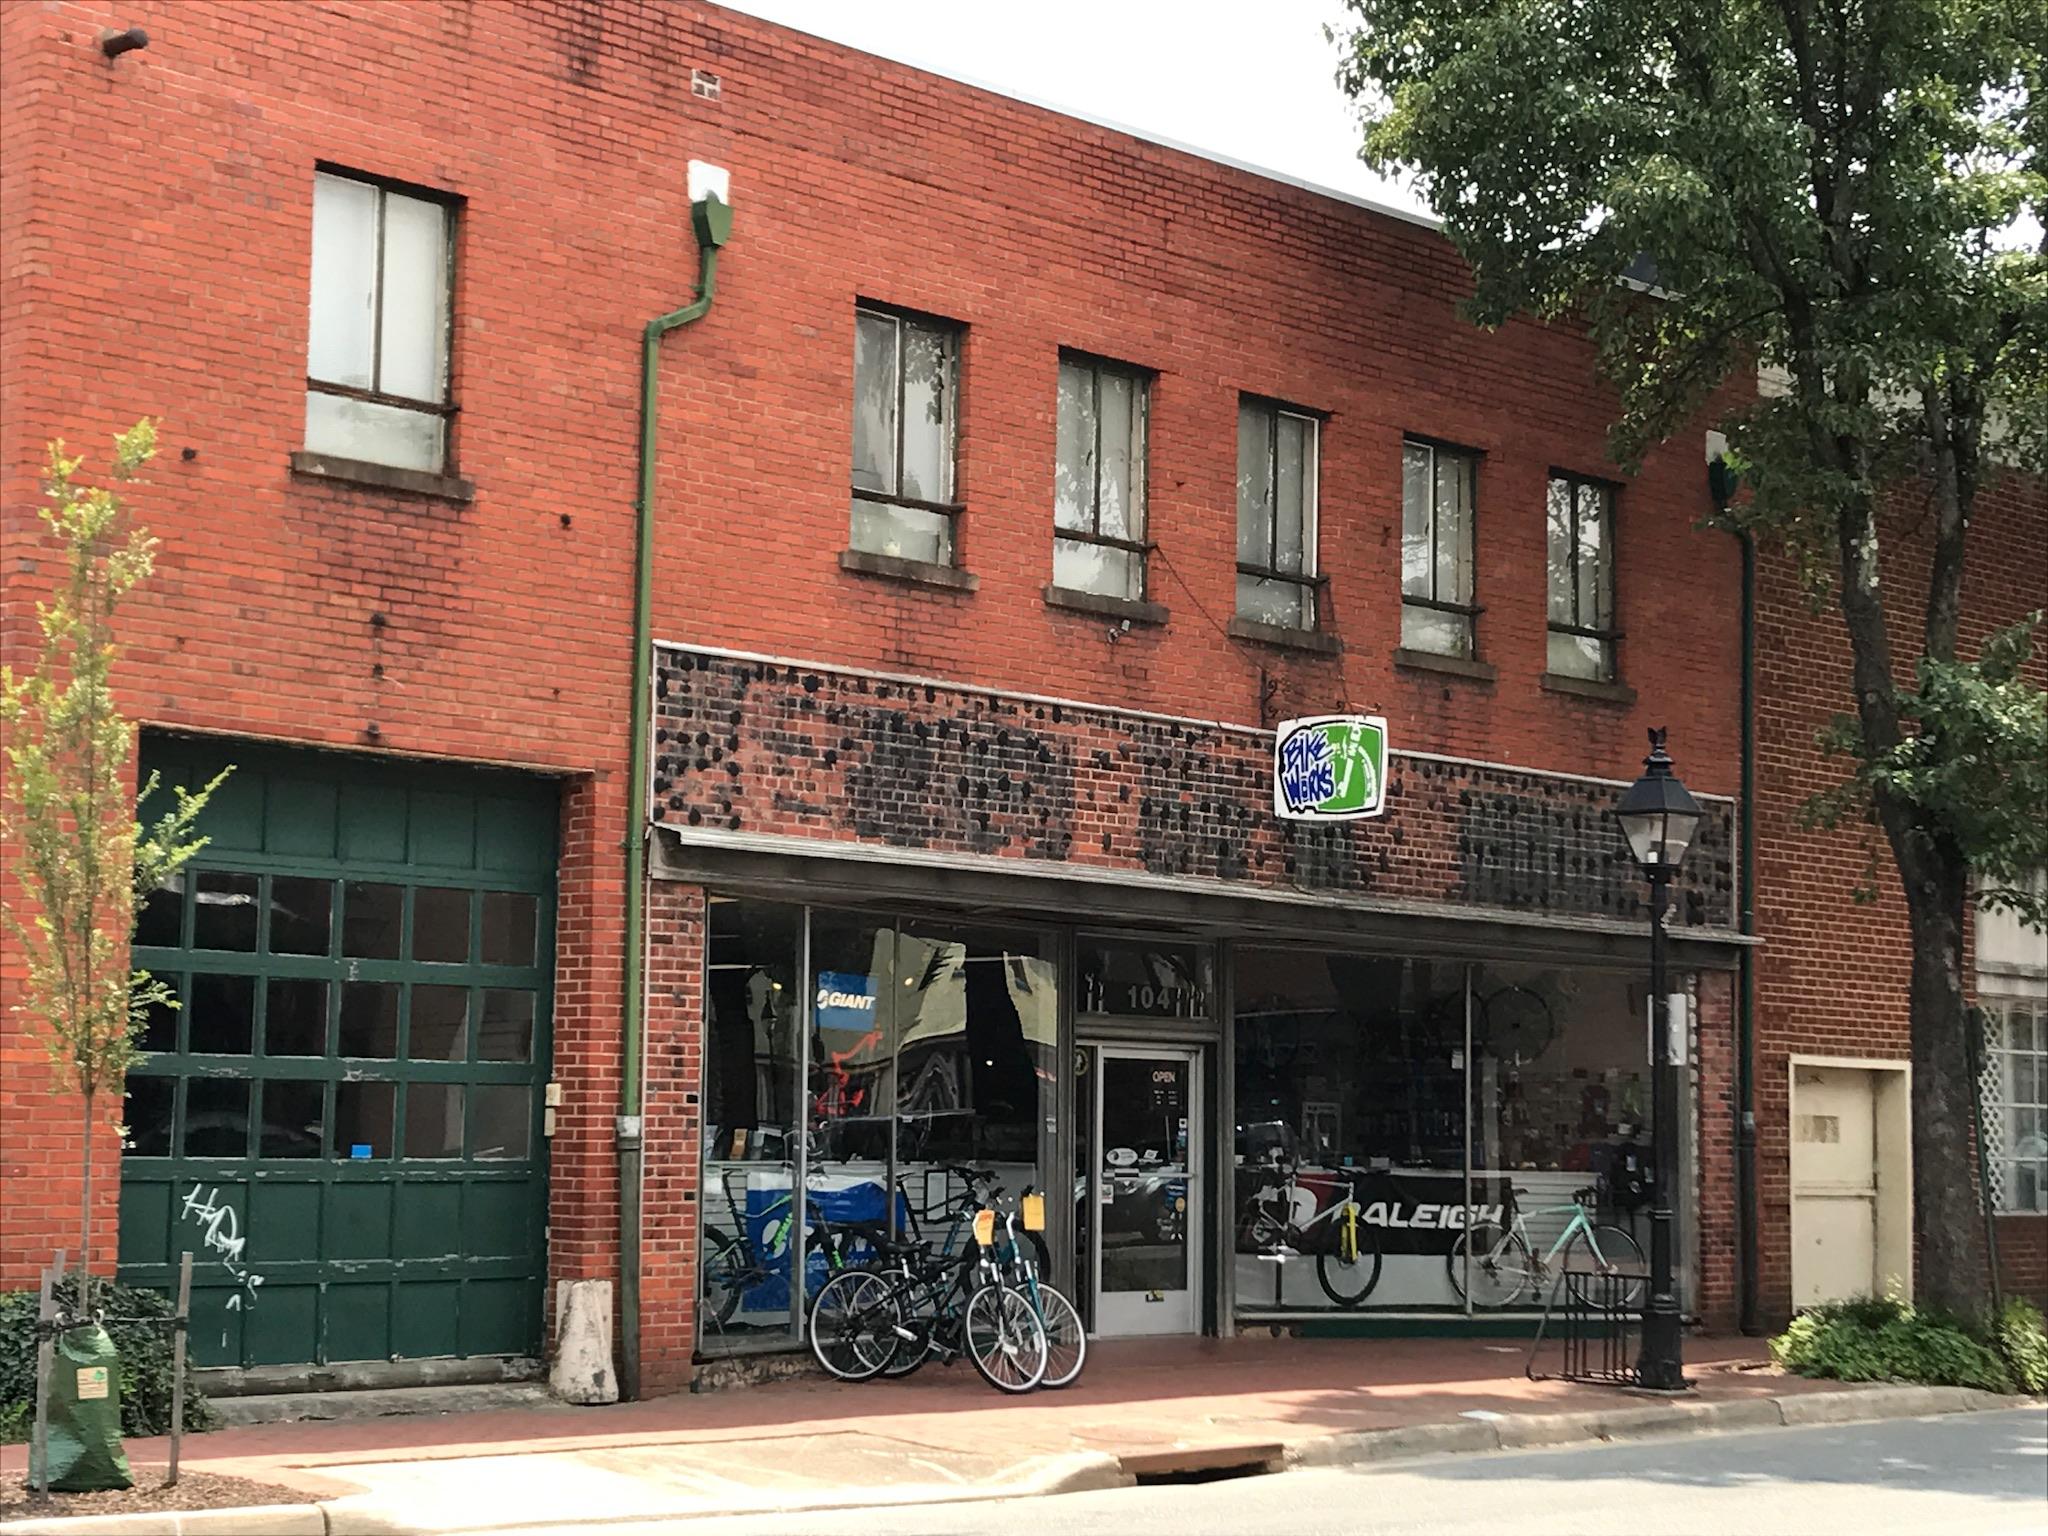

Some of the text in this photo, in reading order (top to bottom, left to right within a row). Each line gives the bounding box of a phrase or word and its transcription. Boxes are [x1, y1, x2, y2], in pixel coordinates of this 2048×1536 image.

[828, 991, 876, 1010] GIANT
[1128, 985, 1170, 1009] 104
[1152, 1071, 1175, 1083] OPEN
[1331, 1202, 1504, 1229] RALEIGH
